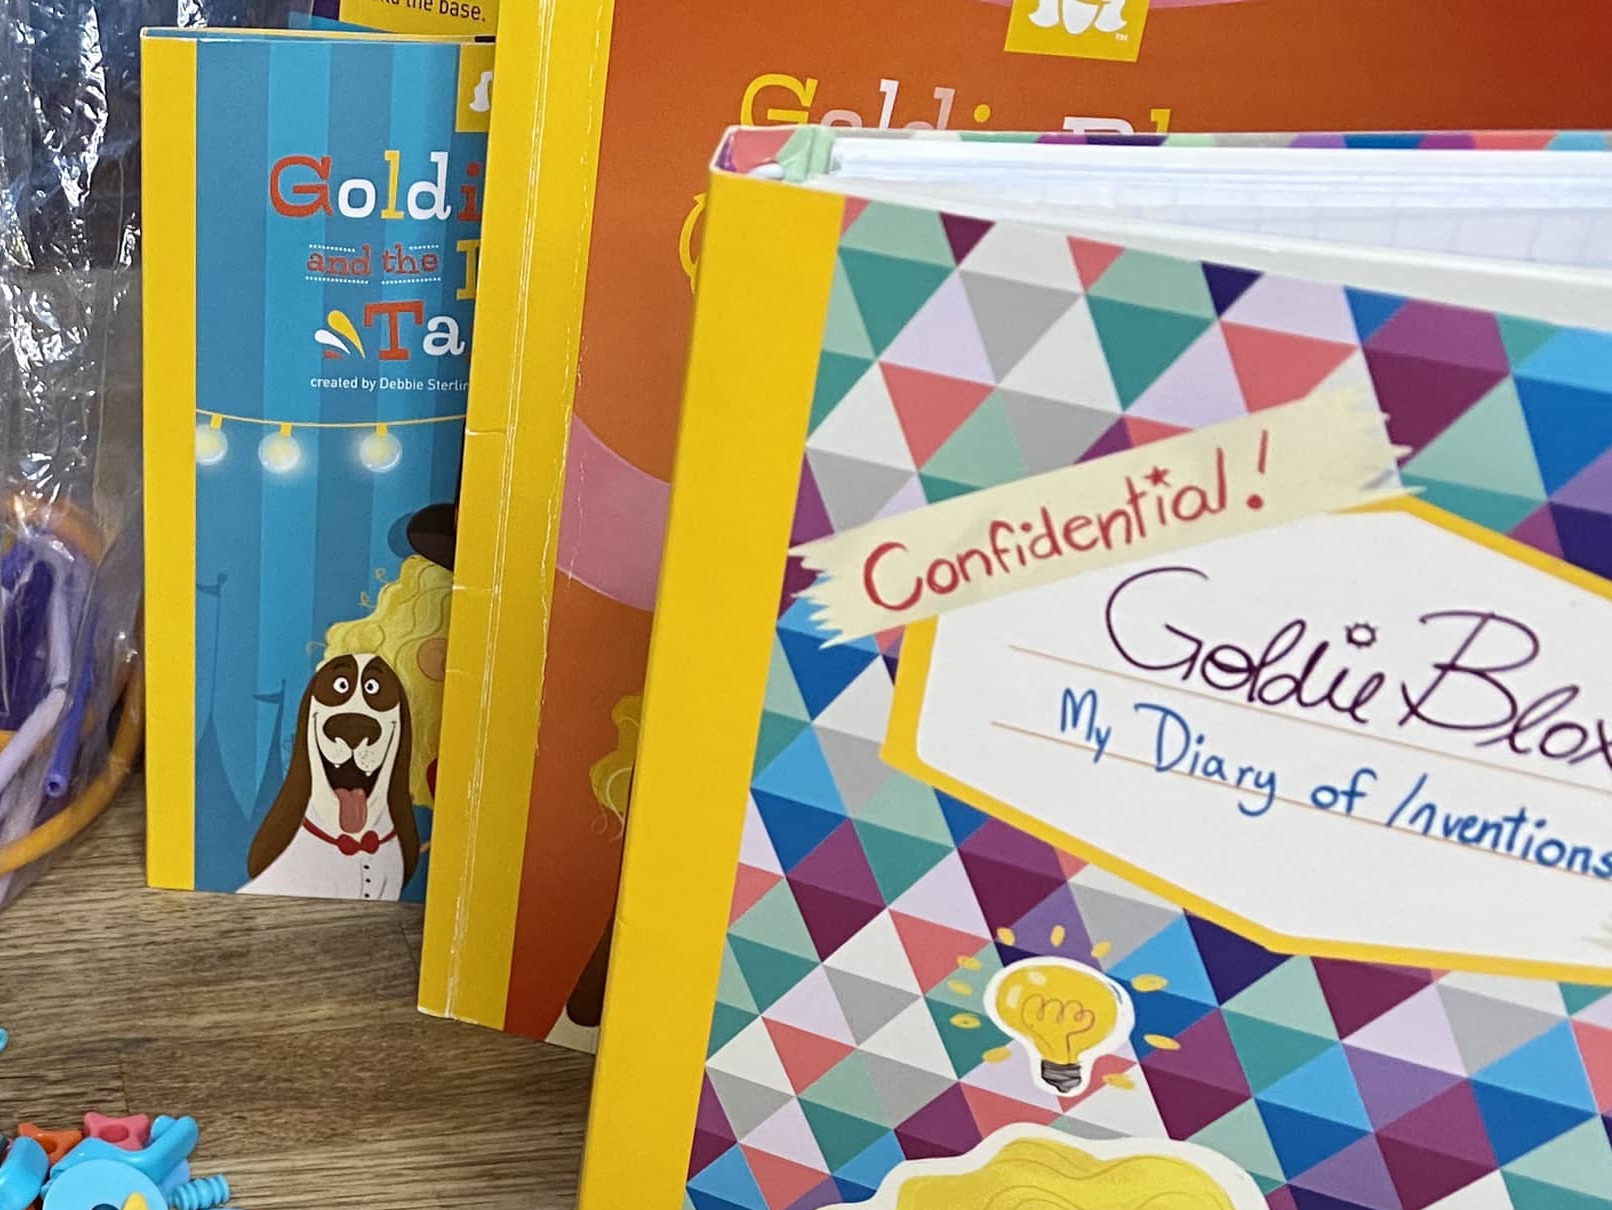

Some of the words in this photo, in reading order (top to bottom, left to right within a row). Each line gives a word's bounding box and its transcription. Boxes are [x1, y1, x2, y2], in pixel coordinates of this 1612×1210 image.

[306, 244, 372, 276] and
[382, 243, 440, 275] the
[364, 300, 471, 361] Ta
[310, 376, 358, 390] created
[361, 376, 377, 392] by
[380, 377, 424, 391] Debbie
[1059, 687, 1112, 764] My
[1134, 702, 1278, 819] Diary
[1310, 767, 1379, 817] of
